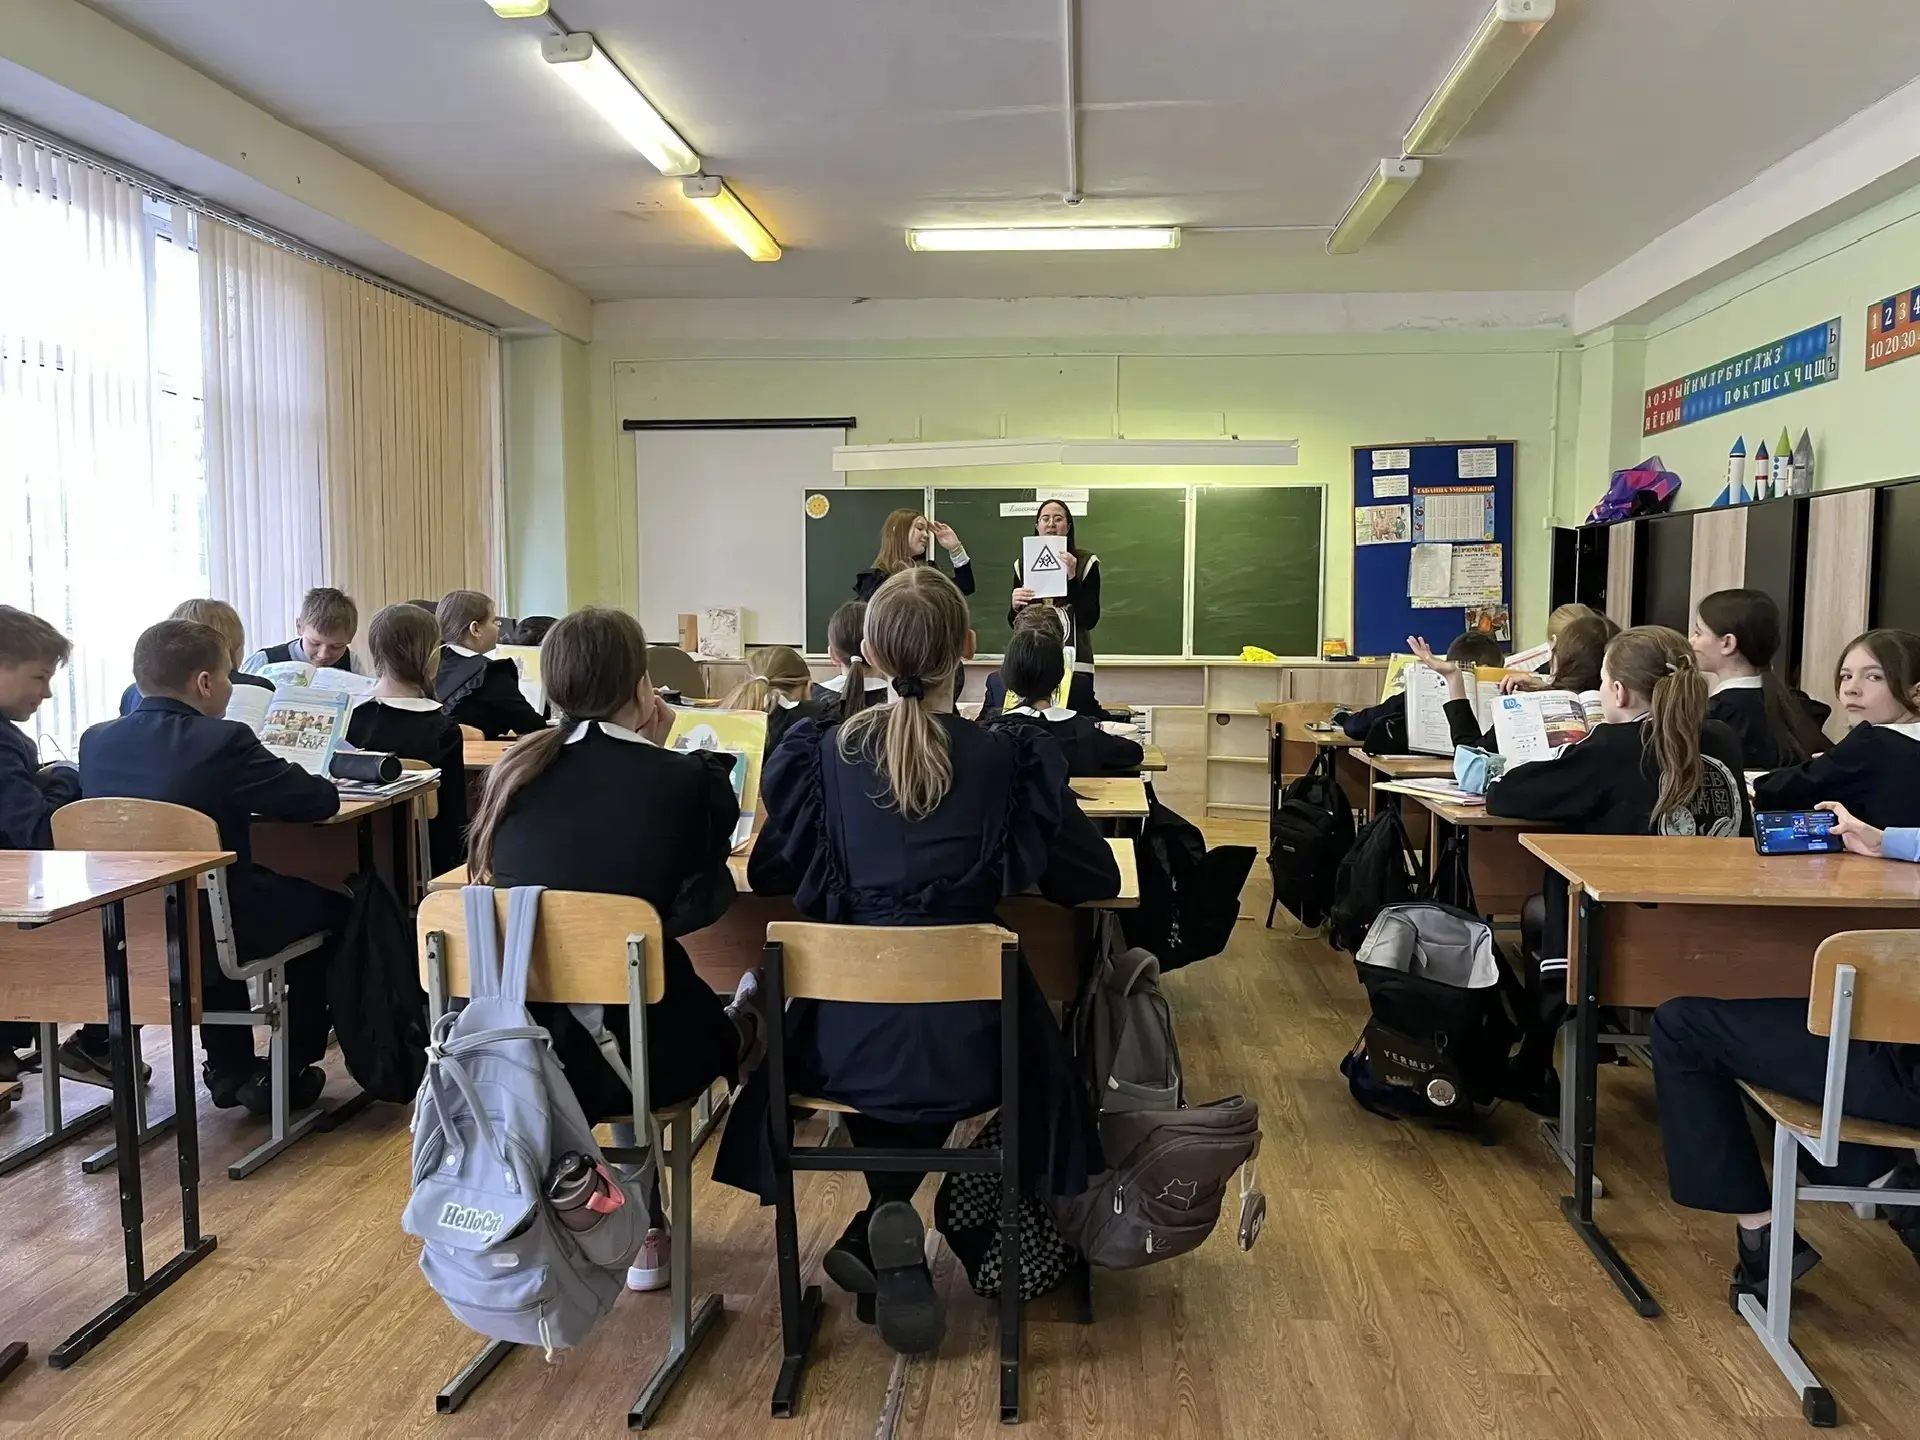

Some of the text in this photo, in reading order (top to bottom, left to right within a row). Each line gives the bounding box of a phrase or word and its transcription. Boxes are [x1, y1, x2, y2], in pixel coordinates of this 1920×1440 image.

[1872, 312, 1878, 330] 1
[1884, 307, 1892, 326] 2
[1899, 302, 1906, 320] 3
[1870, 330, 1916, 360] 10 20 30
[440, 1204, 502, 1232] HelloCat
